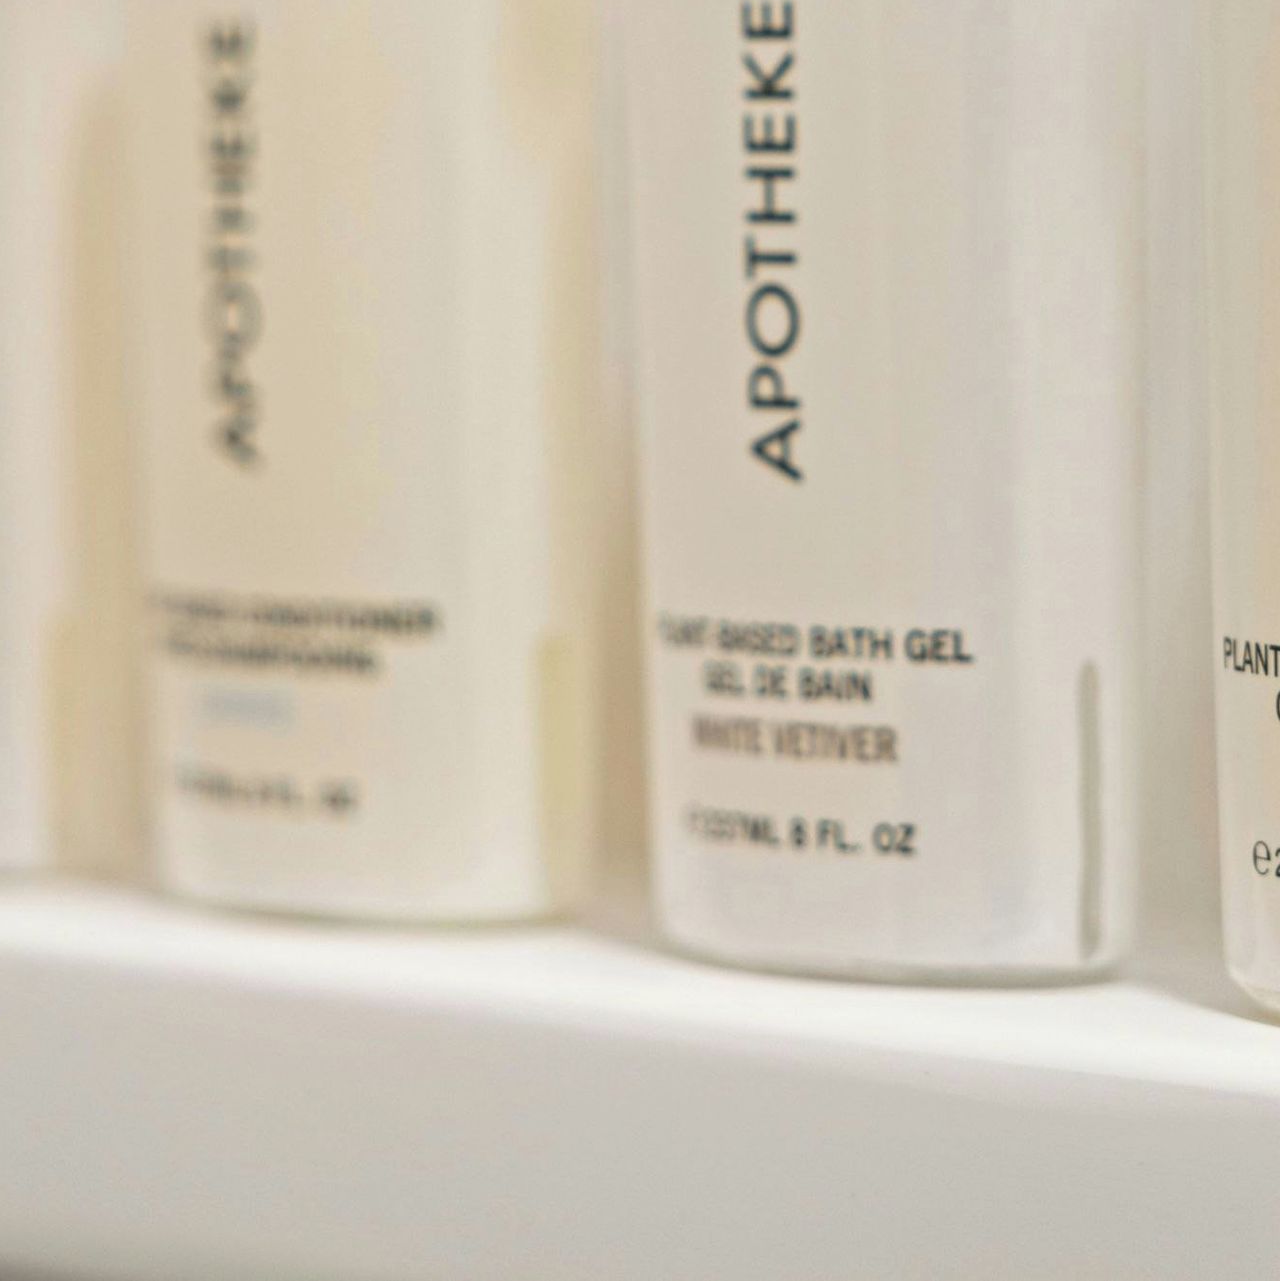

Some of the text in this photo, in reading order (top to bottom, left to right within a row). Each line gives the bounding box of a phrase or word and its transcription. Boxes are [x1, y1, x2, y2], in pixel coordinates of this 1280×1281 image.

[741, 0, 804, 483] APOTHEKE
[808, 625, 894, 660] BATH
[903, 628, 974, 665] GEL
[798, 668, 874, 703] BAIN
[871, 822, 917, 858] OZ
